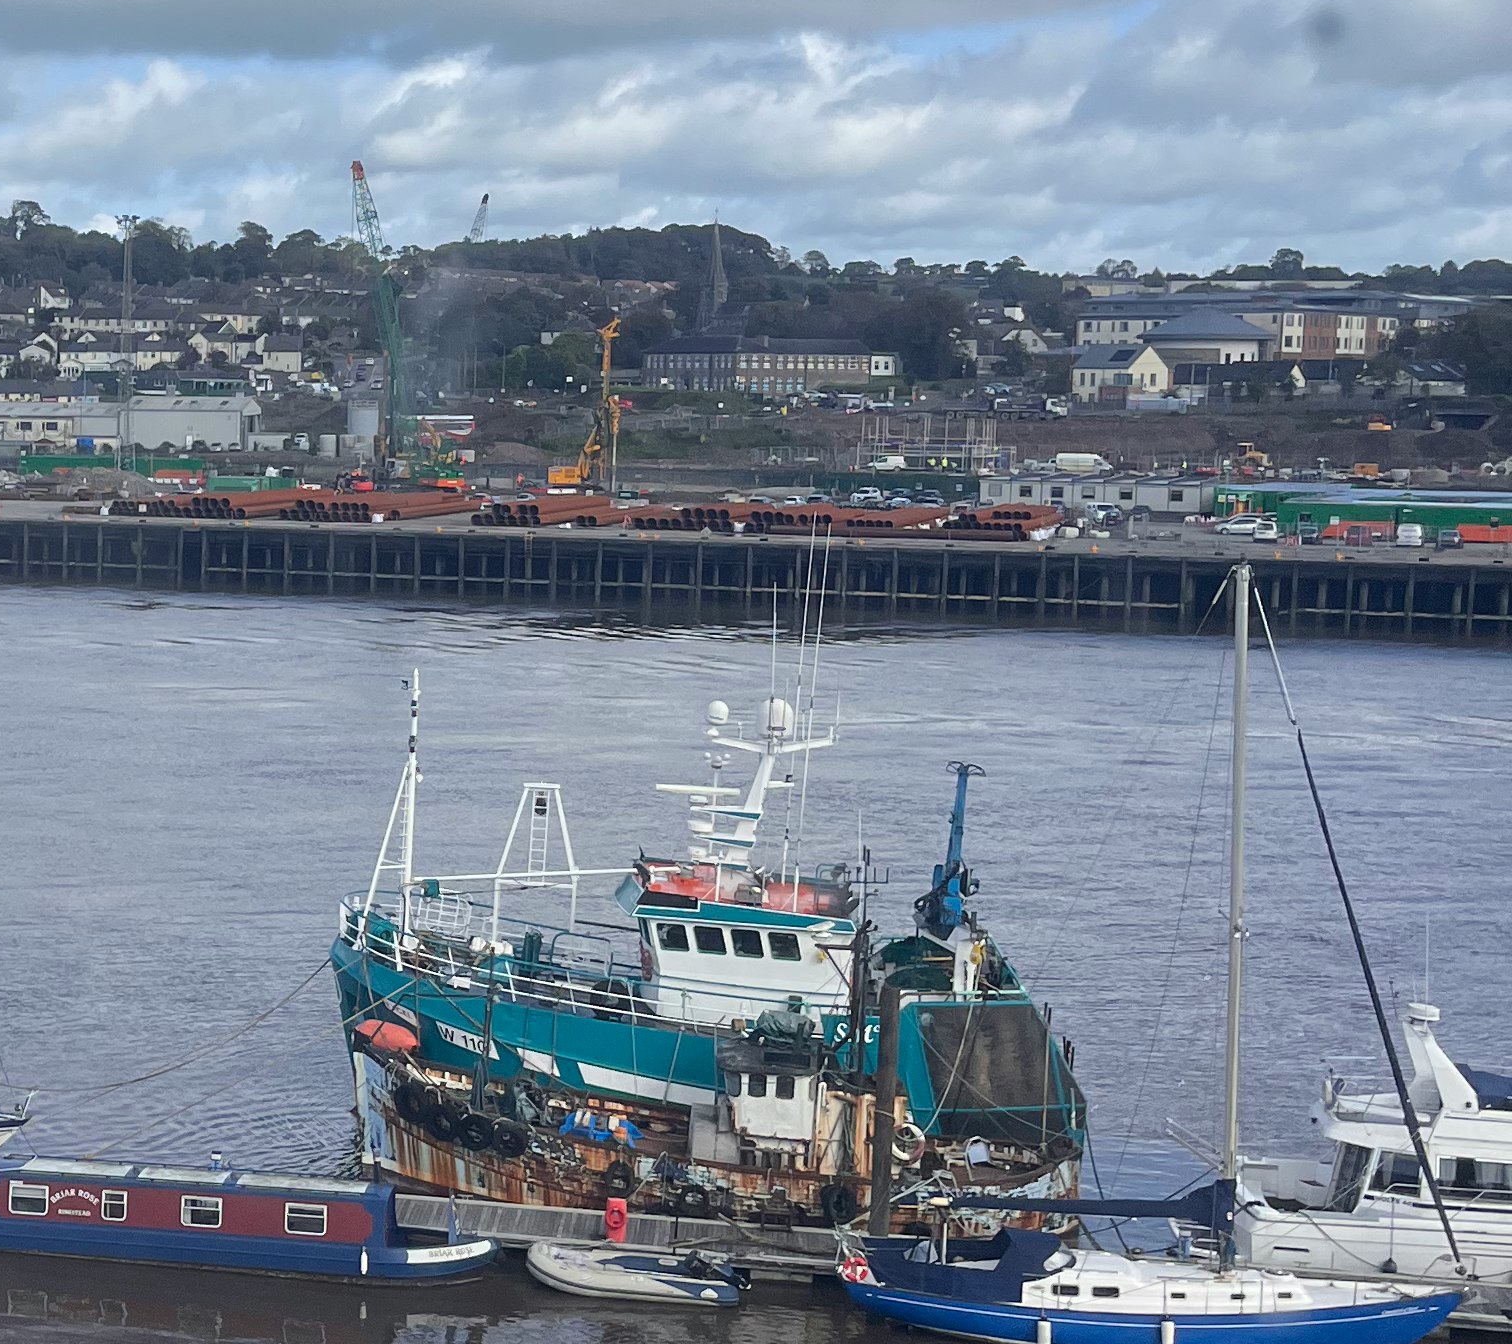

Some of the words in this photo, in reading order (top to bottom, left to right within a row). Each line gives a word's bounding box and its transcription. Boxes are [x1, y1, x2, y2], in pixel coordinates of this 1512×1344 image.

[440, 1025, 455, 1042] W
[50, 1188, 76, 1204] BRIAR
[78, 1189, 100, 1206] ROSE
